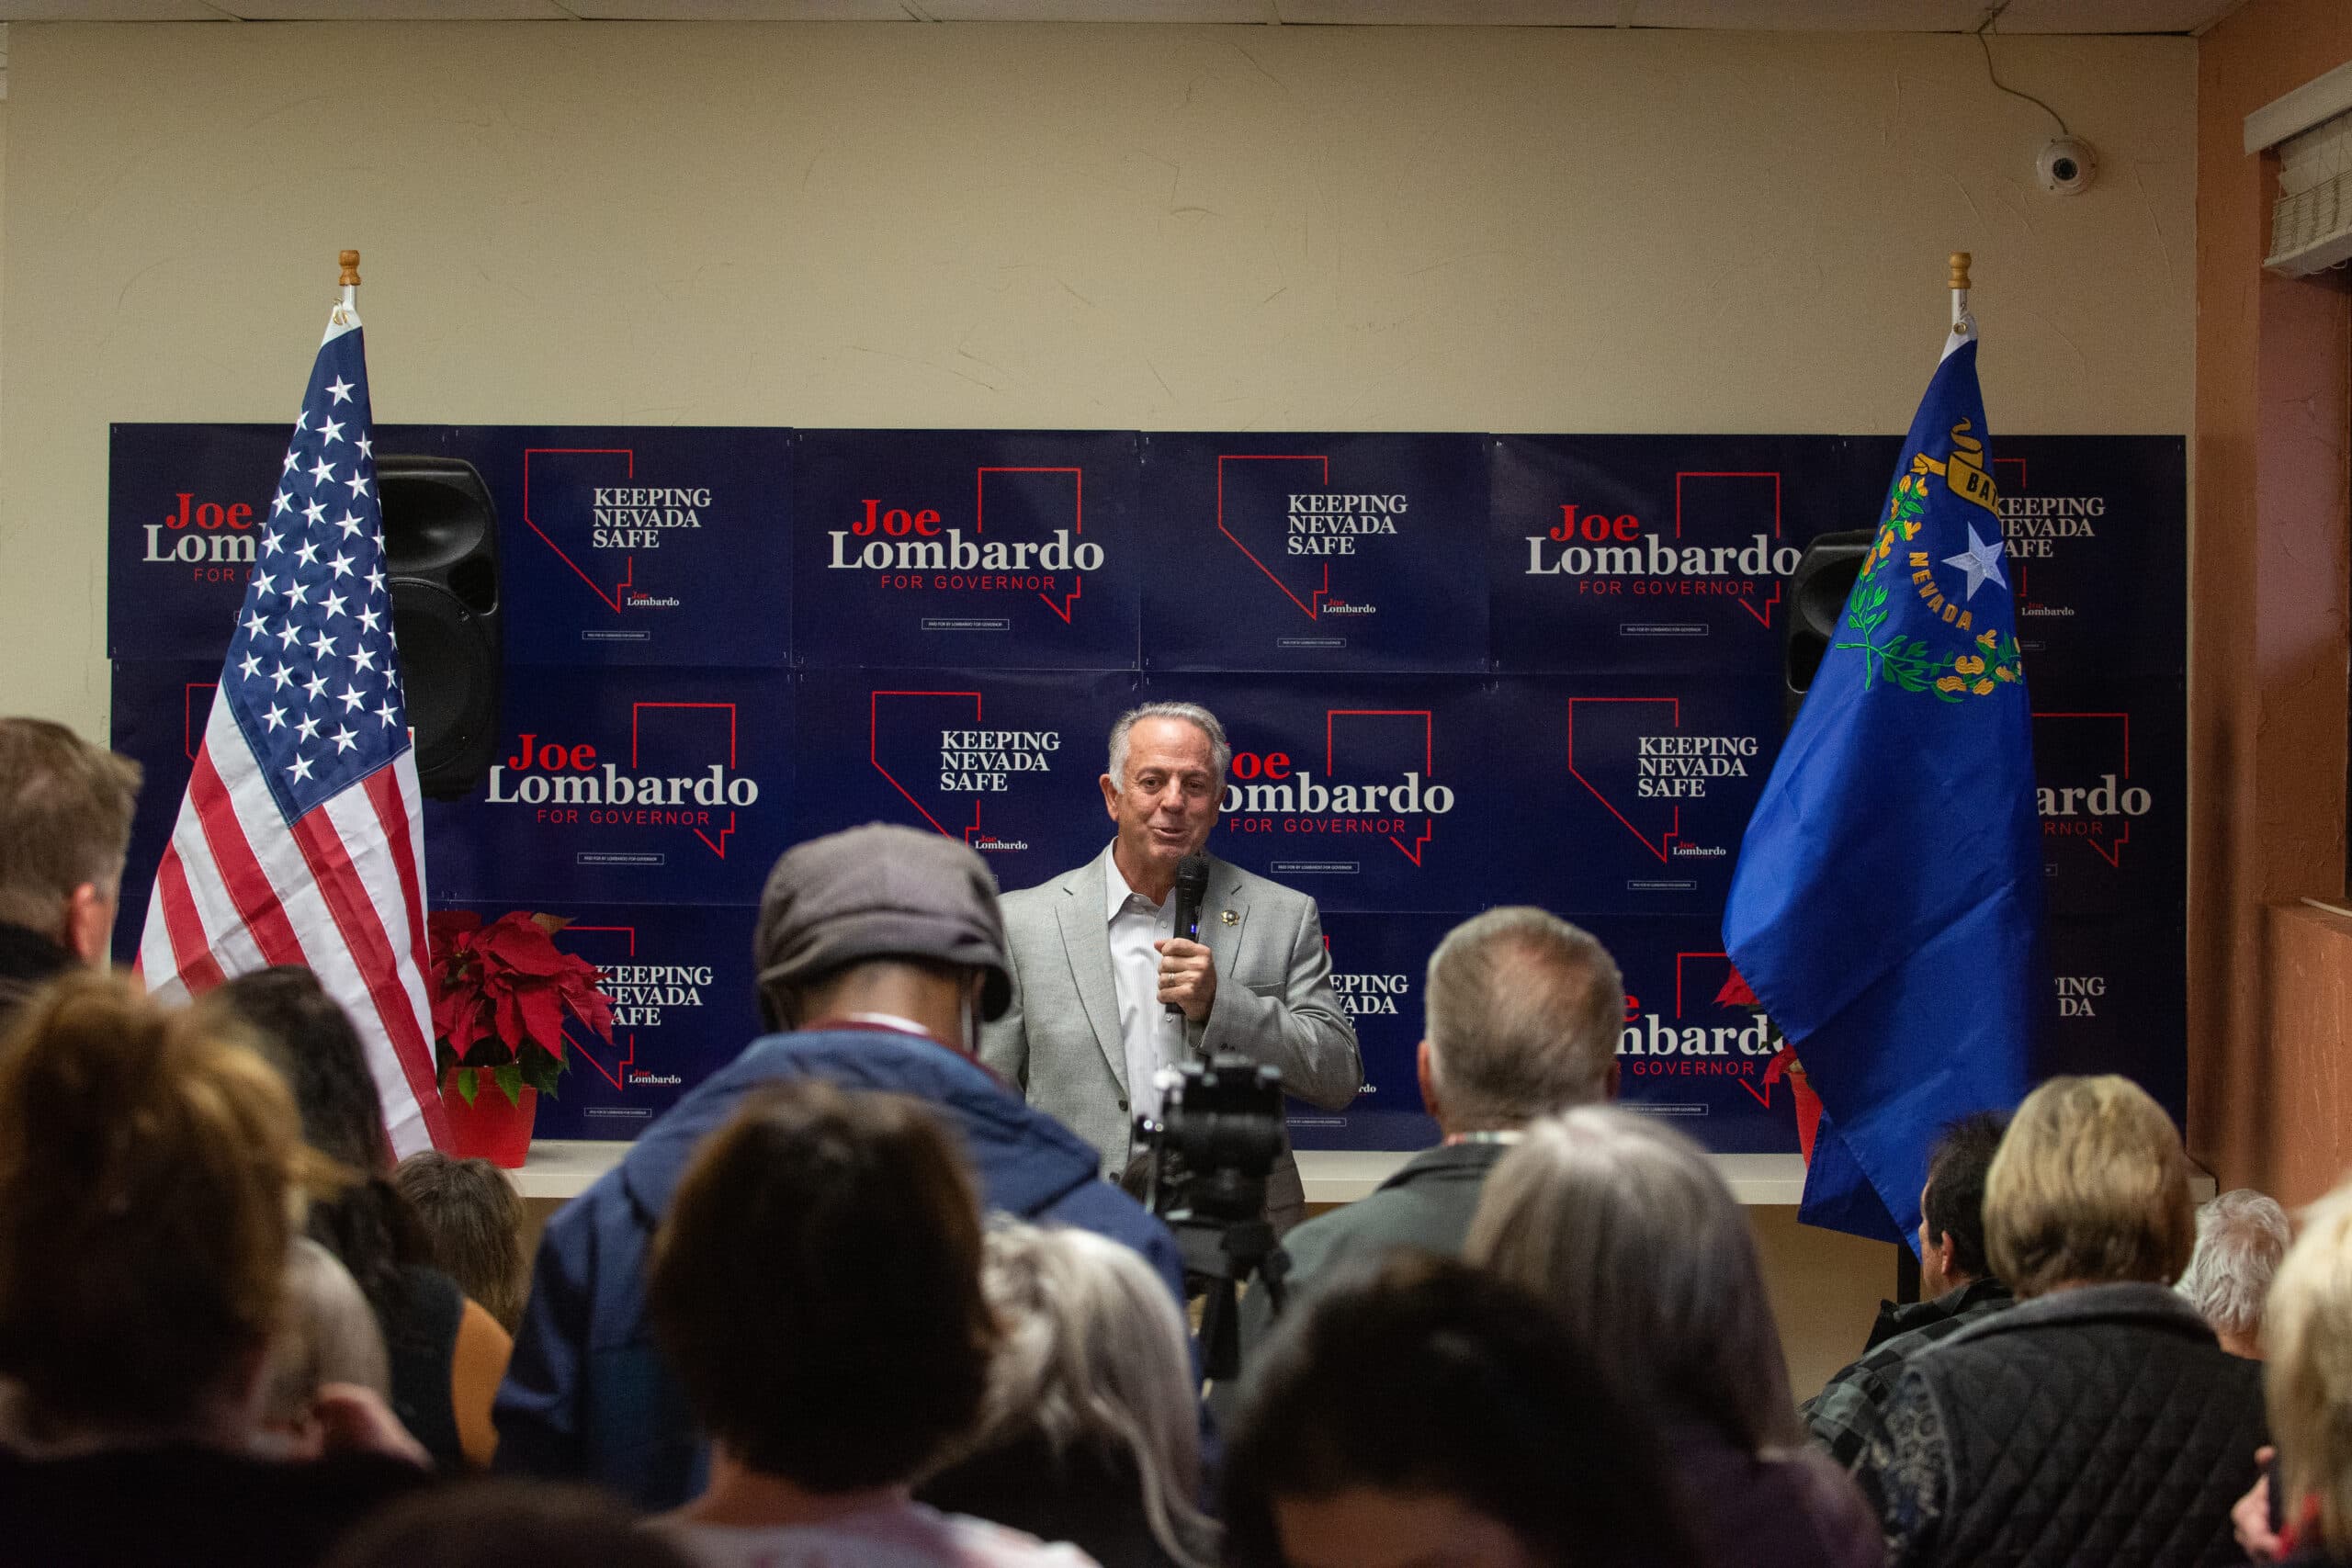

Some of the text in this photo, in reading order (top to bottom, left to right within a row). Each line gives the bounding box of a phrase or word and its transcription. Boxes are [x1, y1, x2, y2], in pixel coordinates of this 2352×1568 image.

[594, 488, 712, 507] KEEPING
[1288, 494, 1408, 514] KEEPING
[165, 492, 253, 530] Joe
[593, 509, 701, 528] NEVADA
[852, 499, 942, 536] Joe
[1287, 515, 1397, 535] NEVADA
[1550, 504, 1640, 541] Joe
[141, 522, 266, 562] Lom
[593, 529, 660, 548] SAFE
[1287, 536, 1355, 555] SAFE
[827, 528, 1104, 570] Lombardo
[1525, 534, 1802, 576] Lombardo
[2005, 539, 2053, 558] AFE
[194, 568, 235, 581] FOR
[881, 575, 1056, 591] FOR GOVERNOR
[1579, 581, 1755, 595] FOR GOVERNOR
[1909, 551, 1973, 631] NEVADA
[627, 597, 680, 606] Lombardo
[1323, 604, 1376, 613] Lombardo
[2021, 606, 2075, 615] Lombardo
[941, 730, 1061, 750] KEEPING
[1638, 737, 1758, 756] KEEPING
[508, 734, 596, 771] Joe
[940, 751, 1050, 771] NEVADA
[1226, 742, 1291, 779] oe
[1637, 758, 1748, 777] NEVADA
[484, 763, 759, 807] Lombardo
[940, 772, 1008, 791] SAFE
[1638, 779, 1706, 797] SAFE
[1219, 772, 1454, 814] ombardo
[537, 809, 709, 825] FOR GOVERNOR
[1230, 818, 1405, 833] FOR GOVERNOR
[975, 840, 1028, 850] Lombardo
[1673, 847, 1726, 855] Lombardo
[2055, 976, 2107, 996] ING
[1339, 996, 1398, 1014] ADA
[611, 1008, 661, 1026] AFE
[1614, 1013, 1784, 1056] bard
[1633, 1061, 1755, 1076] GOVERNOR
[628, 1075, 682, 1084] Lombardo
